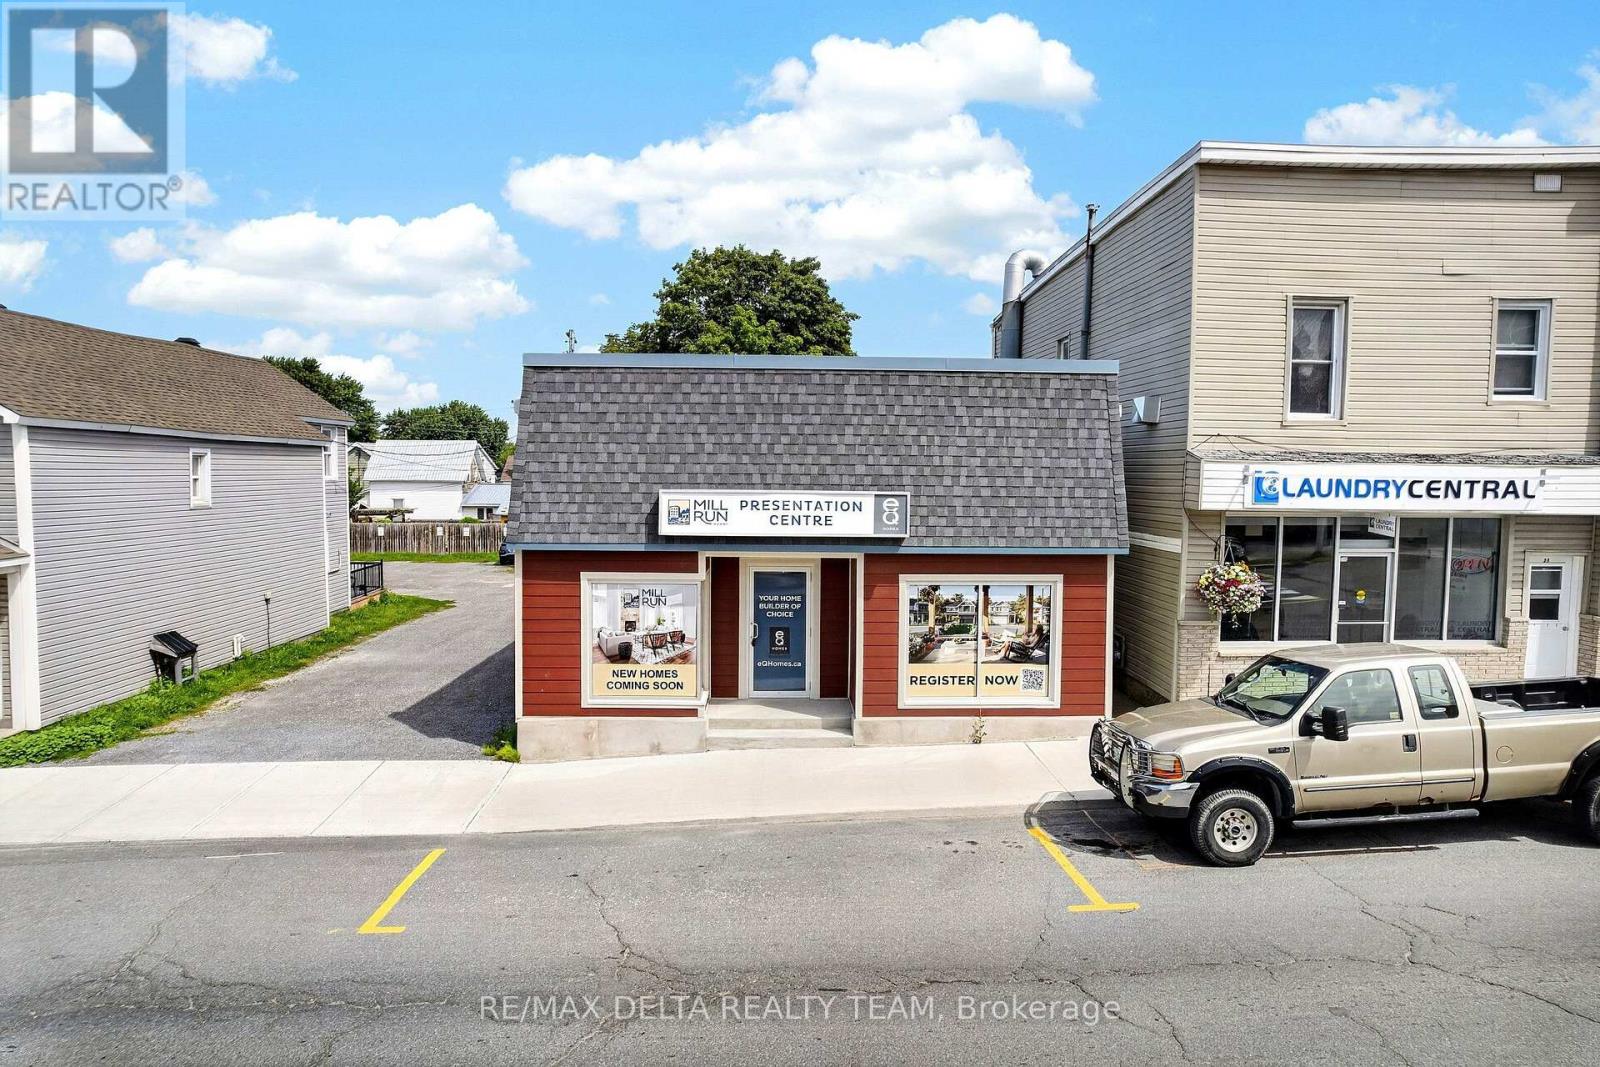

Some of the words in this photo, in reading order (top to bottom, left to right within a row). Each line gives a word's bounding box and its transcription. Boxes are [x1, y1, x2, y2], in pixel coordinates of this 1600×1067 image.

[693, 499, 728, 510] MILL
[739, 500, 863, 512] PRESENTATION
[693, 511, 728, 525] RUN
[769, 514, 833, 526] CENTRE
[642, 588, 667, 598] MILL
[642, 597, 667, 608] RUN
[612, 669, 637, 678] NEW
[640, 669, 679, 678] HOMES
[606, 681, 650, 690] COMING
[653, 681, 684, 690] SOON
[909, 675, 975, 686] REGISTER
[985, 675, 1019, 686] NOW
